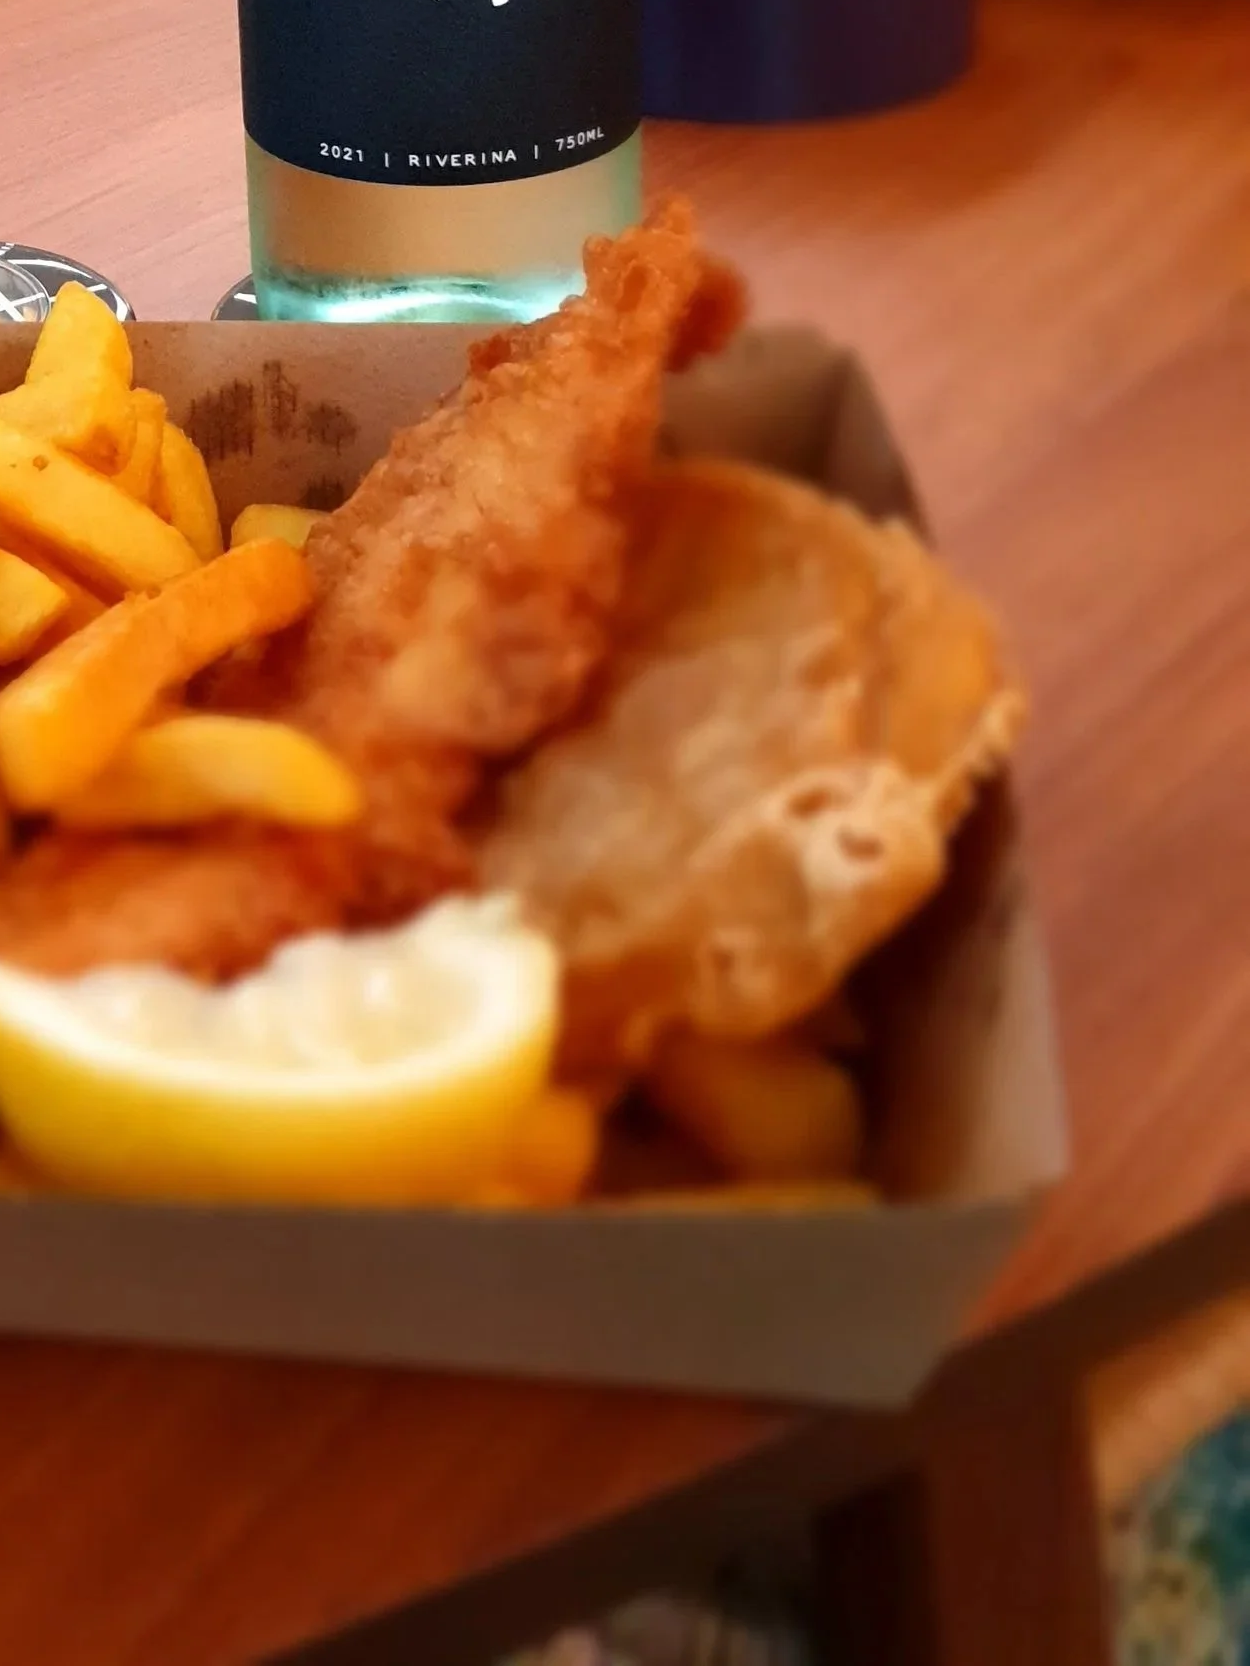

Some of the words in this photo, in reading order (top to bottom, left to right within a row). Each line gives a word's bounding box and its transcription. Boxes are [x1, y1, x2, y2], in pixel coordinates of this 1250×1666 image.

[319, 142, 364, 163] 2021
[408, 148, 517, 167] RIVERINA
[555, 126, 605, 152] 750ML
